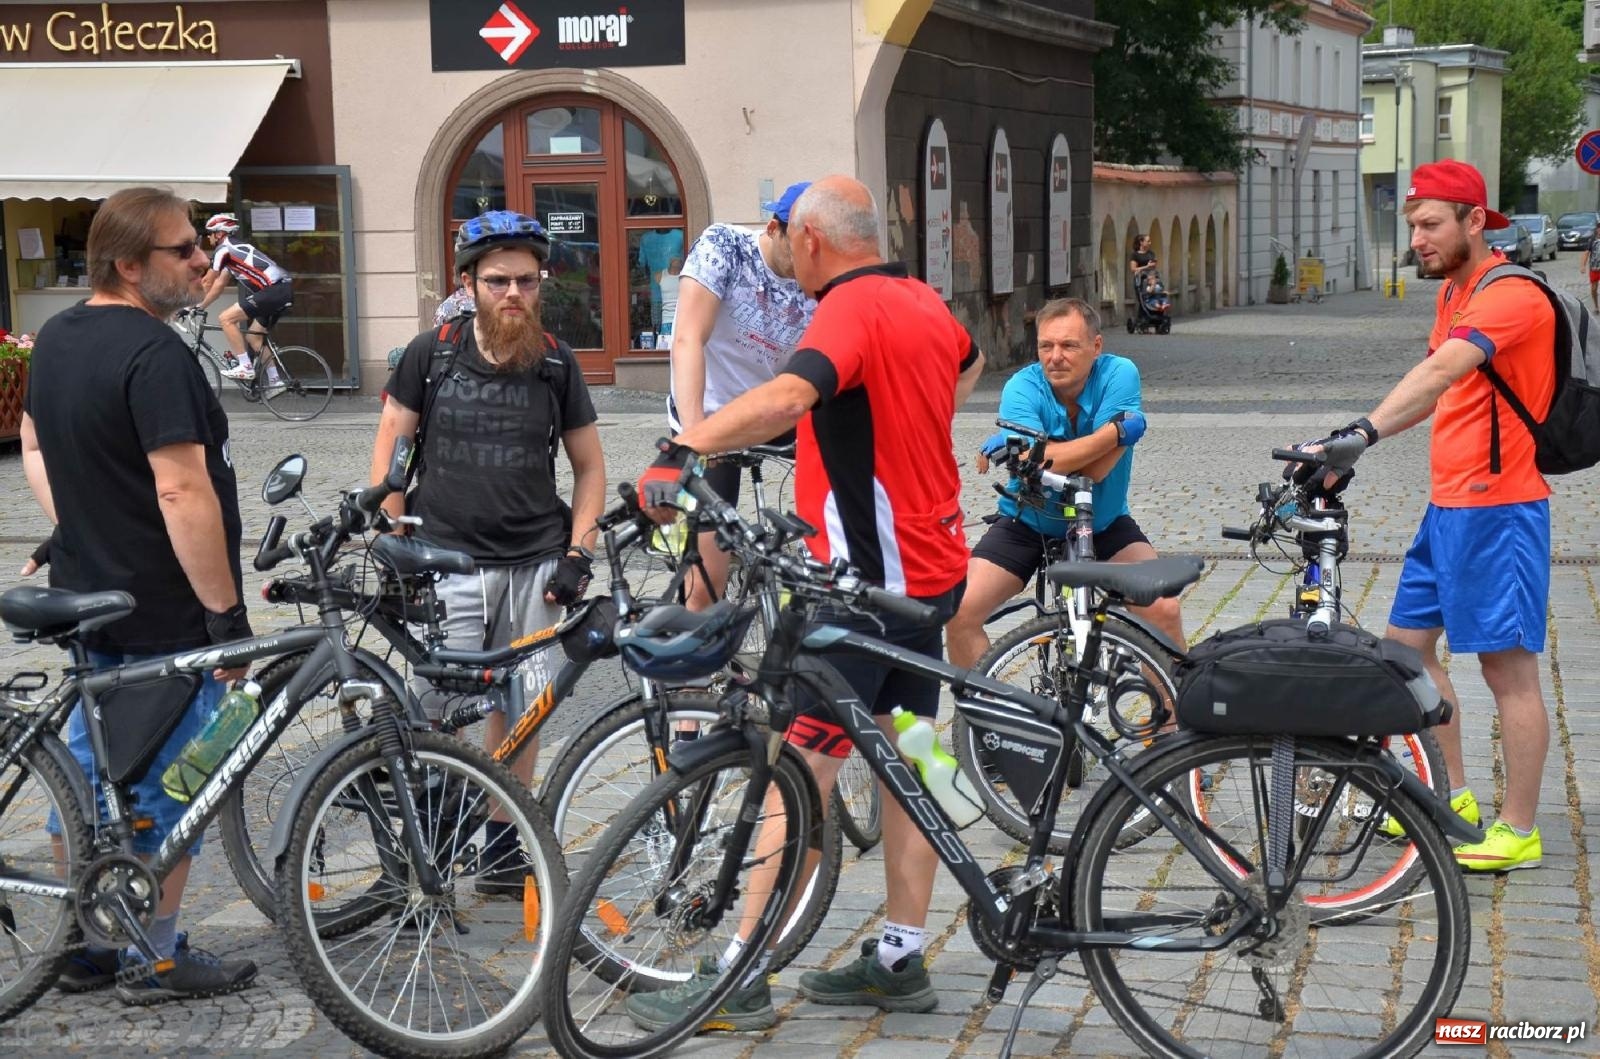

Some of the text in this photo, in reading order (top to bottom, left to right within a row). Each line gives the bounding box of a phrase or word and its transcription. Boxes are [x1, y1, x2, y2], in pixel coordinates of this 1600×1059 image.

[0, 3, 218, 54] w Gałeczka
[179, 685, 290, 840] MERIDA
[836, 699, 973, 864] KROSS
